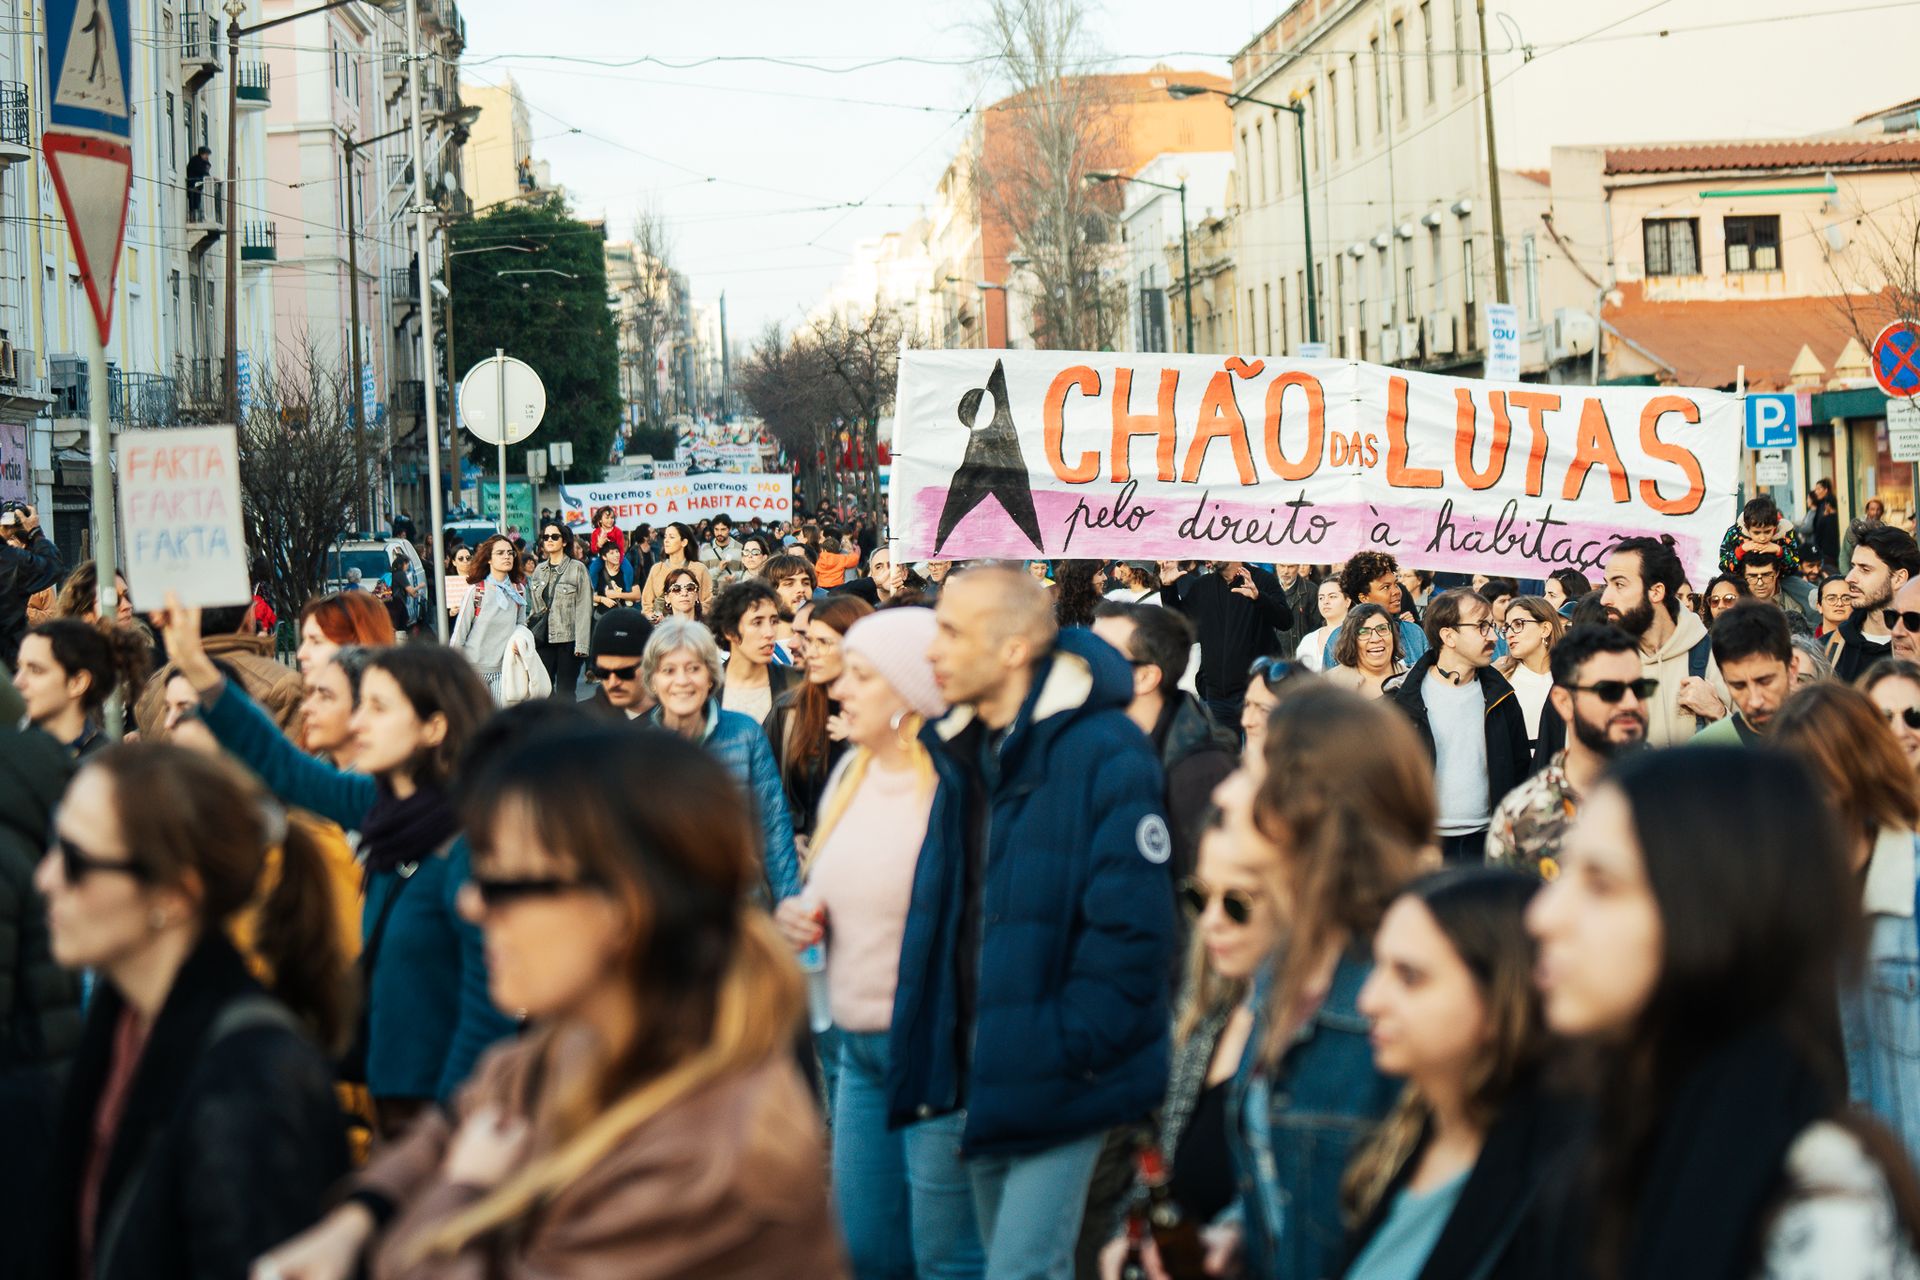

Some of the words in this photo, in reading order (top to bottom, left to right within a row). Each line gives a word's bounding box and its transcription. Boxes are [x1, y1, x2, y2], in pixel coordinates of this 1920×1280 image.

[1043, 355, 1326, 486] CHÃO
[1330, 431, 1379, 468] DAS
[1386, 375, 1706, 516] LUTAS
[1755, 398, 1786, 444] P
[126, 444, 225, 481] FARTA
[127, 487, 228, 523] FARTA
[589, 490, 652, 501] Queremos
[693, 482, 748, 492] Queremos
[590, 502, 658, 518] DREITO
[133, 525, 231, 562] FARTA
[1063, 479, 1155, 552] pelo
[1178, 489, 1338, 546] direito
[1369, 504, 1401, 546] à
[1425, 498, 1631, 571] habitaçã
